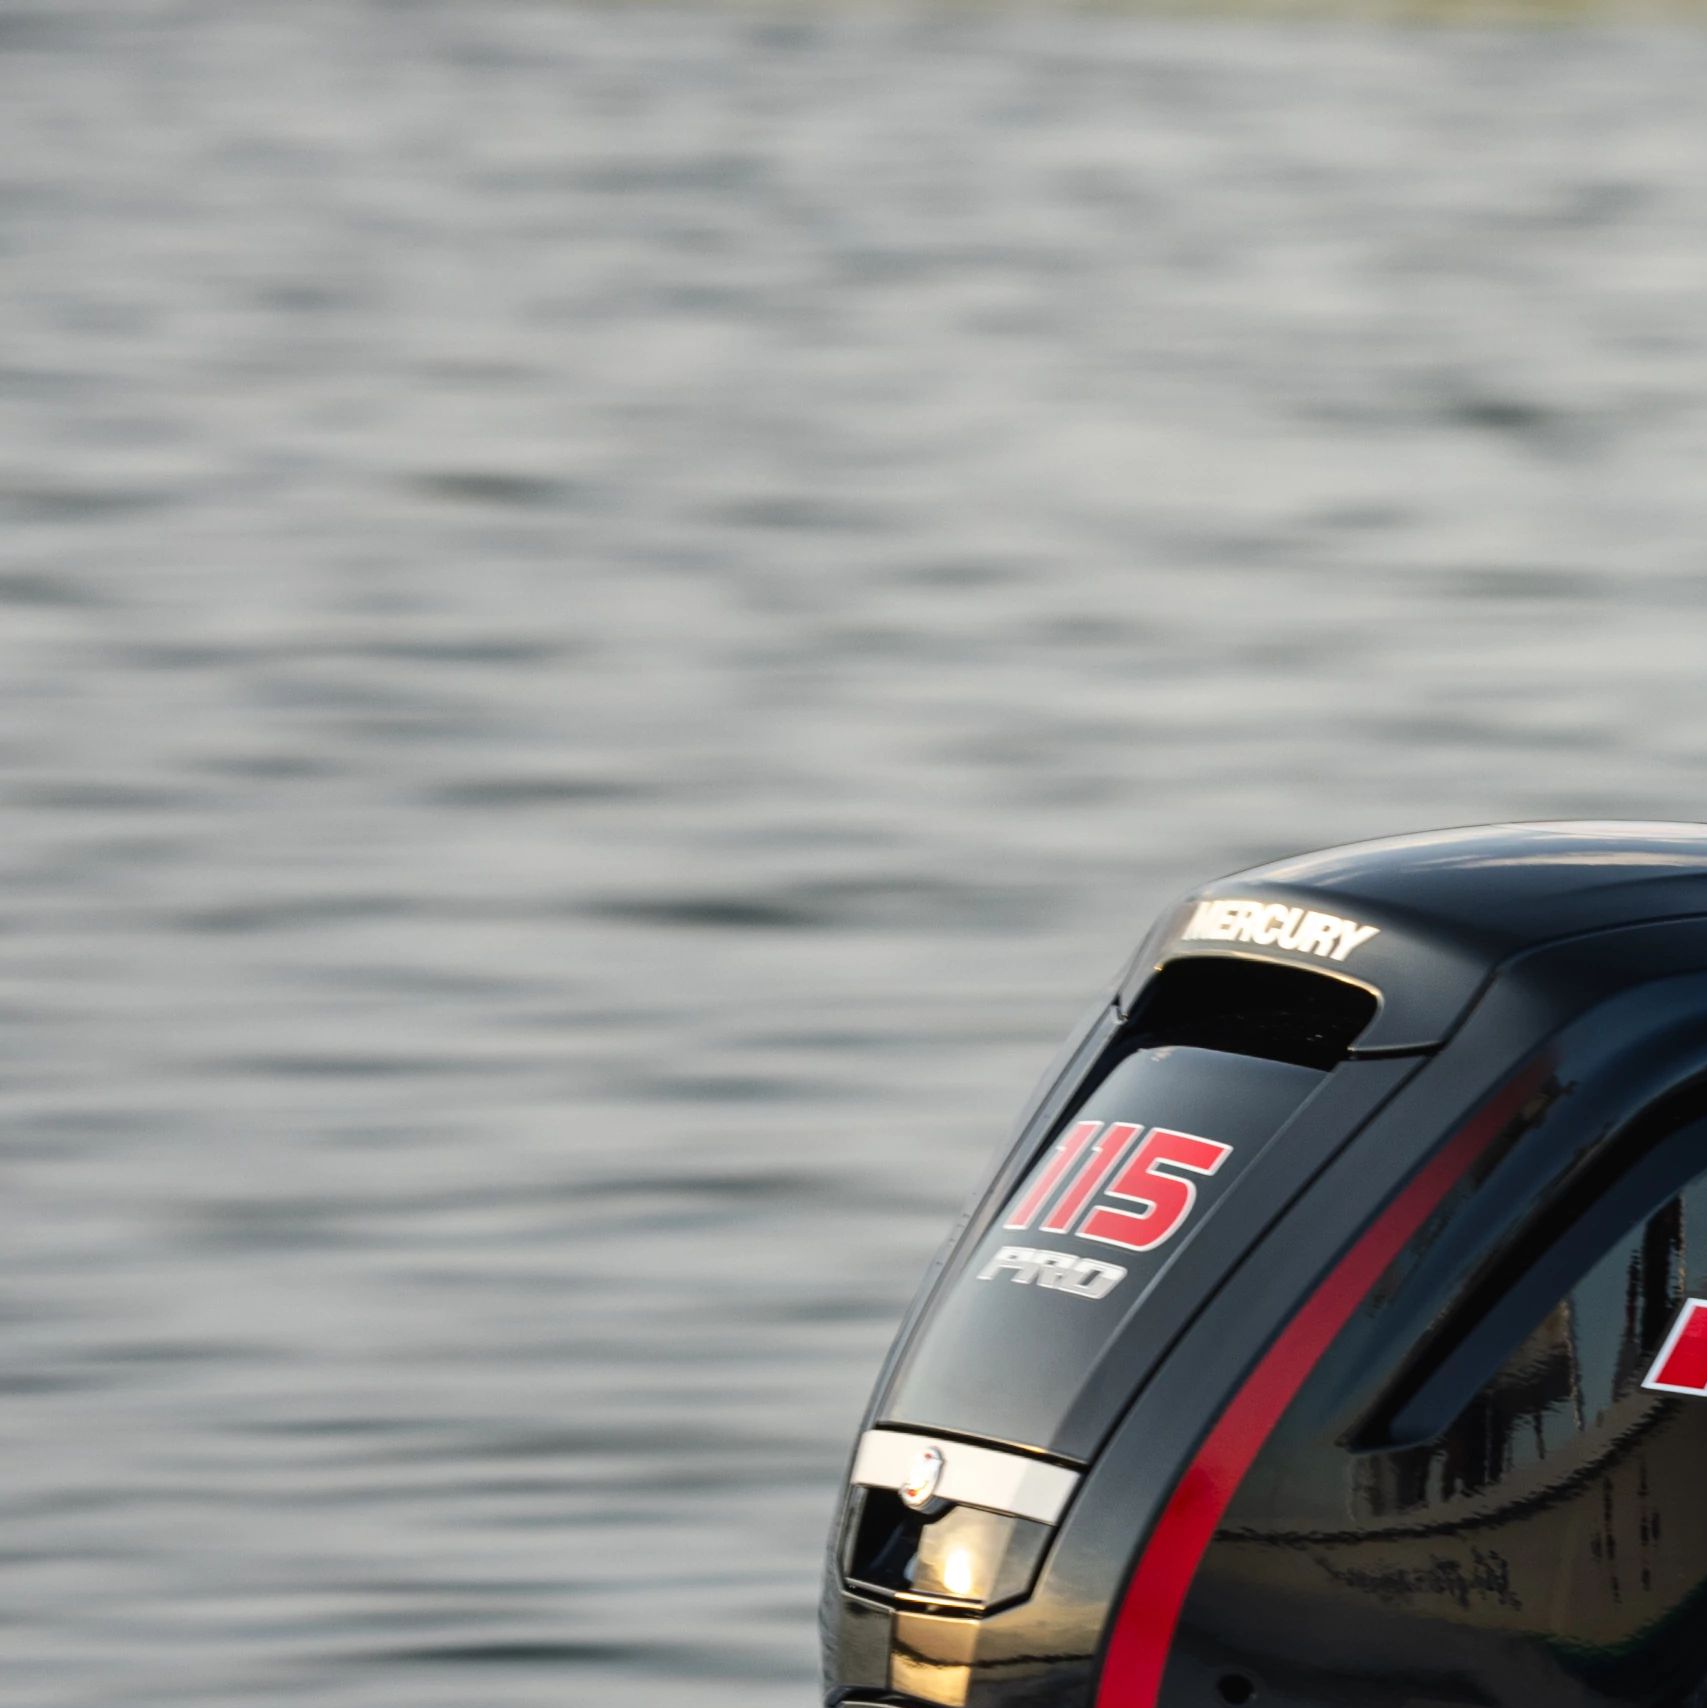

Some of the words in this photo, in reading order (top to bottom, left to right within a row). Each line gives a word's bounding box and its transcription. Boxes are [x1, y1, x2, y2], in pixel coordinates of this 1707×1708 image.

[1180, 899, 1382, 962] MERCURY
[1002, 1119, 1235, 1252] 115
[976, 1245, 1128, 1300] PRO
